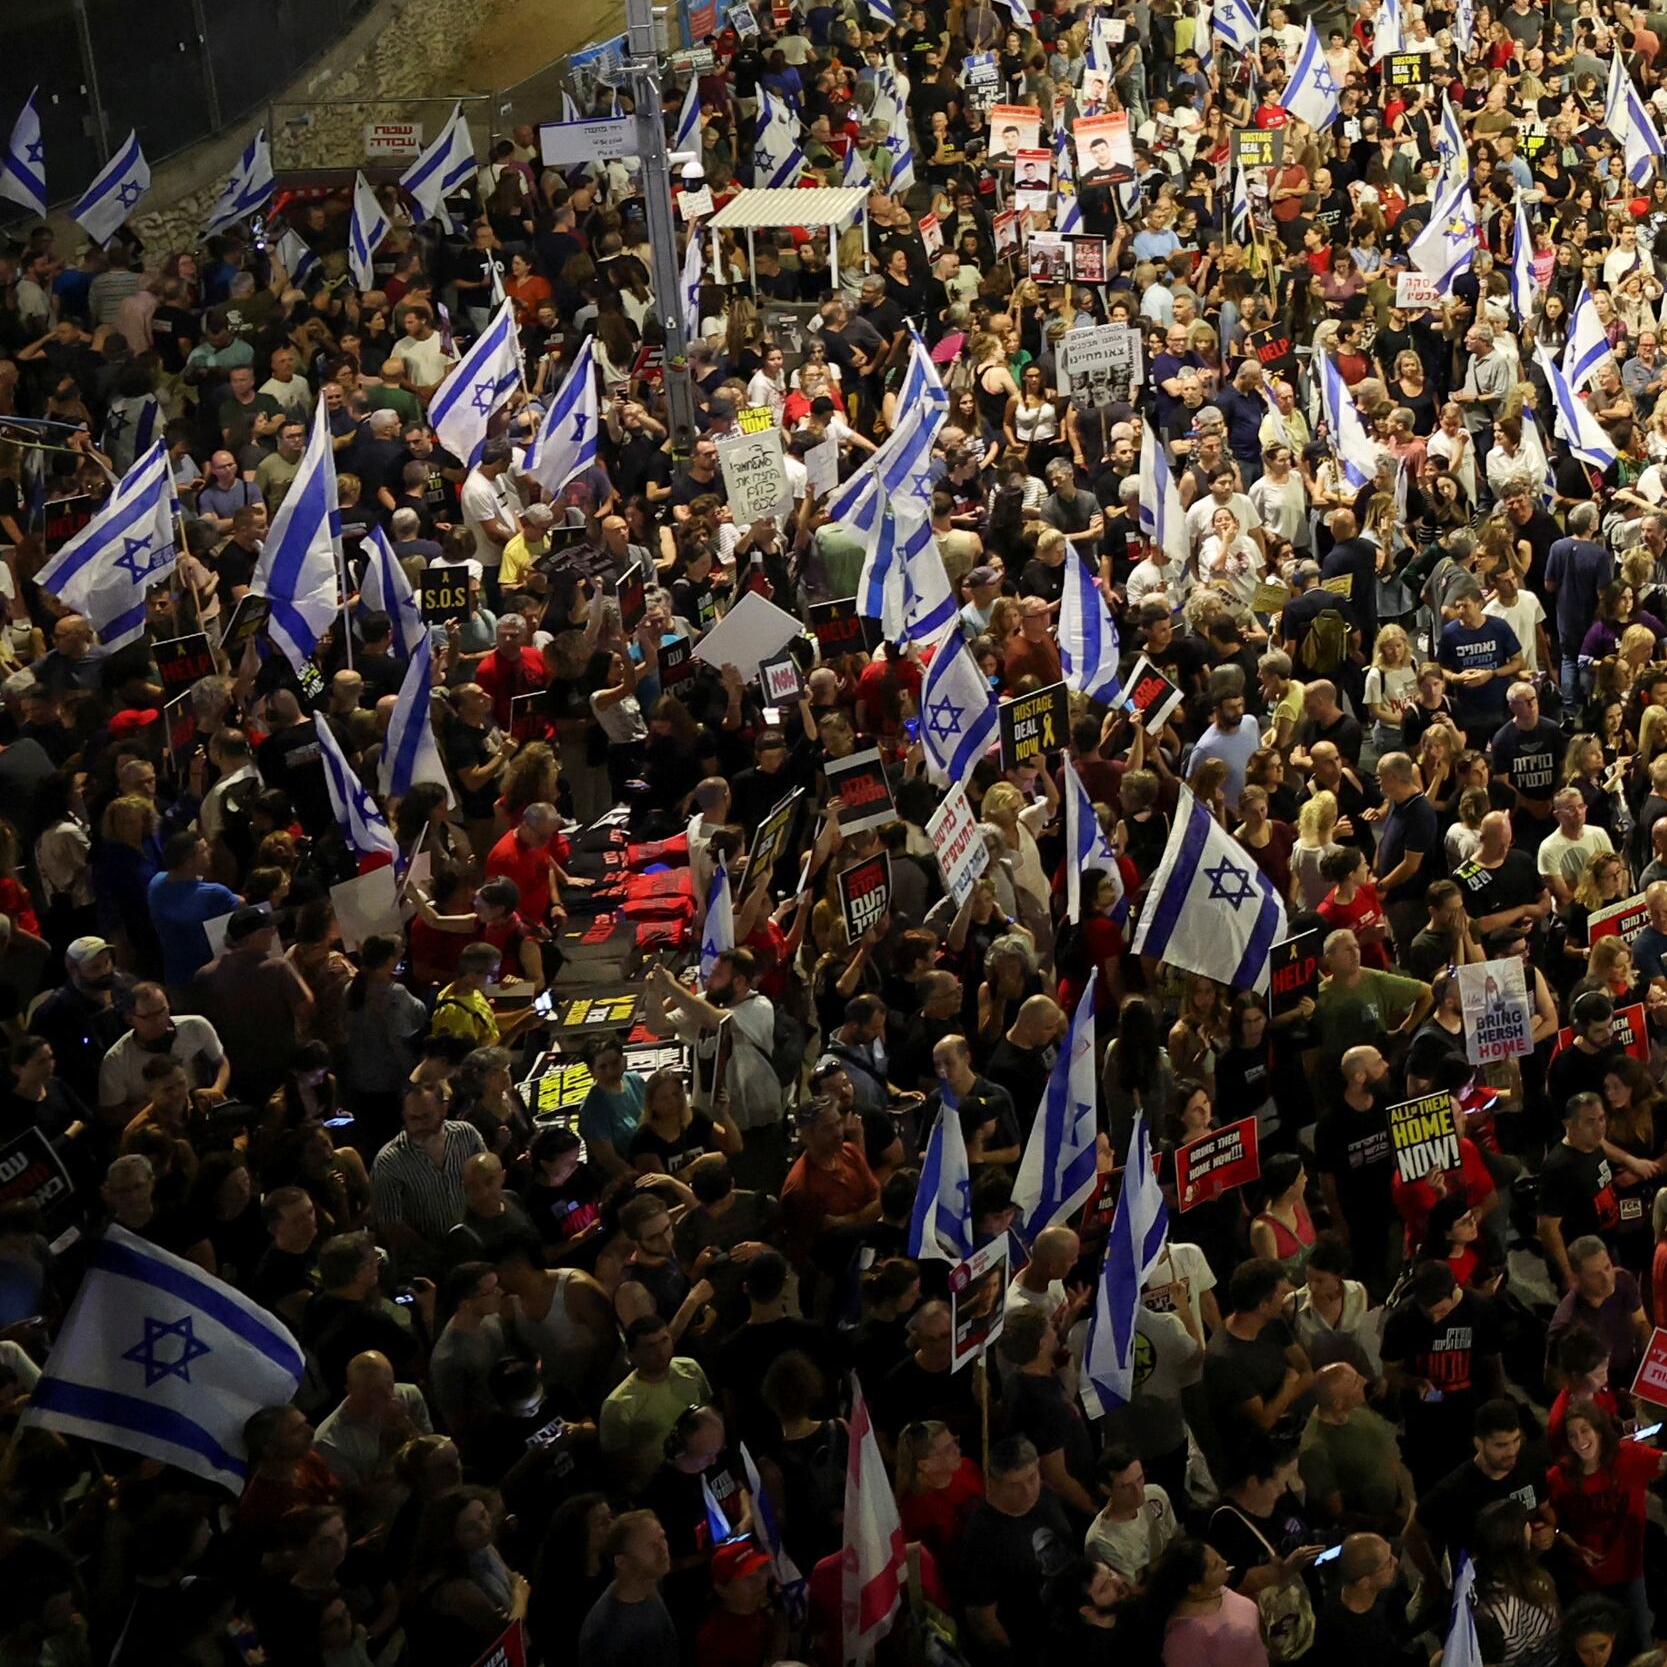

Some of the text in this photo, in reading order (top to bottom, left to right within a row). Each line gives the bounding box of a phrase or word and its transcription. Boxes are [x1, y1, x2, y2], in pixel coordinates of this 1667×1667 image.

[370, 137, 416, 147] עבודה
[374, 126, 414, 135] שטח
[1258, 338, 1291, 364] HELP
[740, 416, 774, 434] HOME
[1013, 697, 1055, 722] HOSTAGE
[1014, 722, 1040, 741] DEAL
[1015, 739, 1042, 763] NOW
[850, 885, 887, 908] העם
[1272, 955, 1318, 995] HELP
[1474, 1011, 1523, 1030] BRING
[1476, 1024, 1524, 1044] HERSH
[1477, 1037, 1527, 1059] HOME
[1391, 1093, 1451, 1123] ALL THEM
[1392, 1110, 1455, 1149] HOME
[1189, 1131, 1241, 1164] BRING THEM
[1396, 1133, 1462, 1183] NOW!
[1188, 1144, 1244, 1182] HOME NOW!!!
